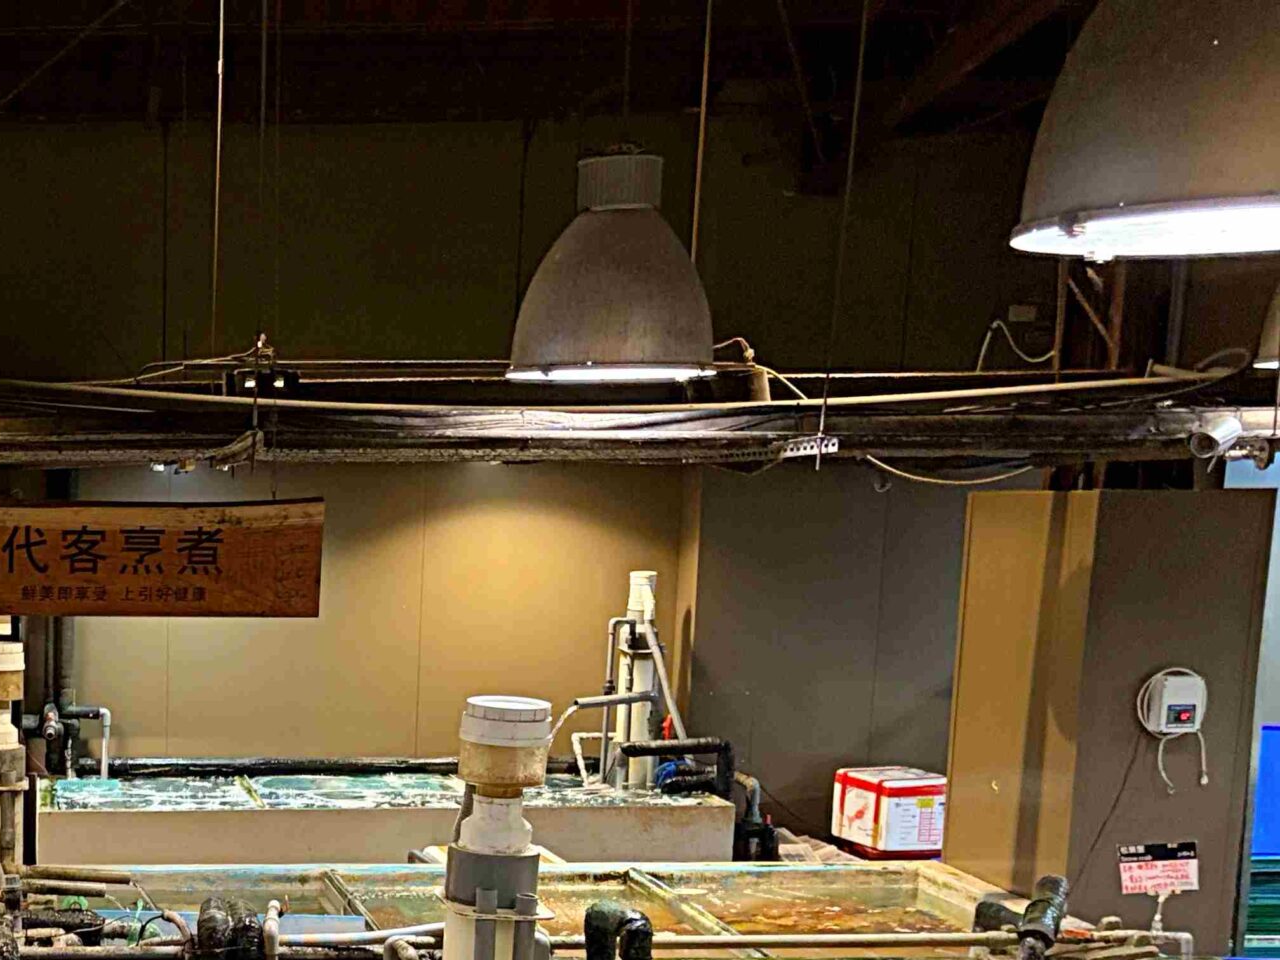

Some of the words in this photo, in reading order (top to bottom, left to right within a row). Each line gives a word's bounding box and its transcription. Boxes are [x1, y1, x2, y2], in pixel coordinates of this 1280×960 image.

[1, 525, 224, 575] 代客烹煮
[21, 585, 108, 601] 鮮美即享受
